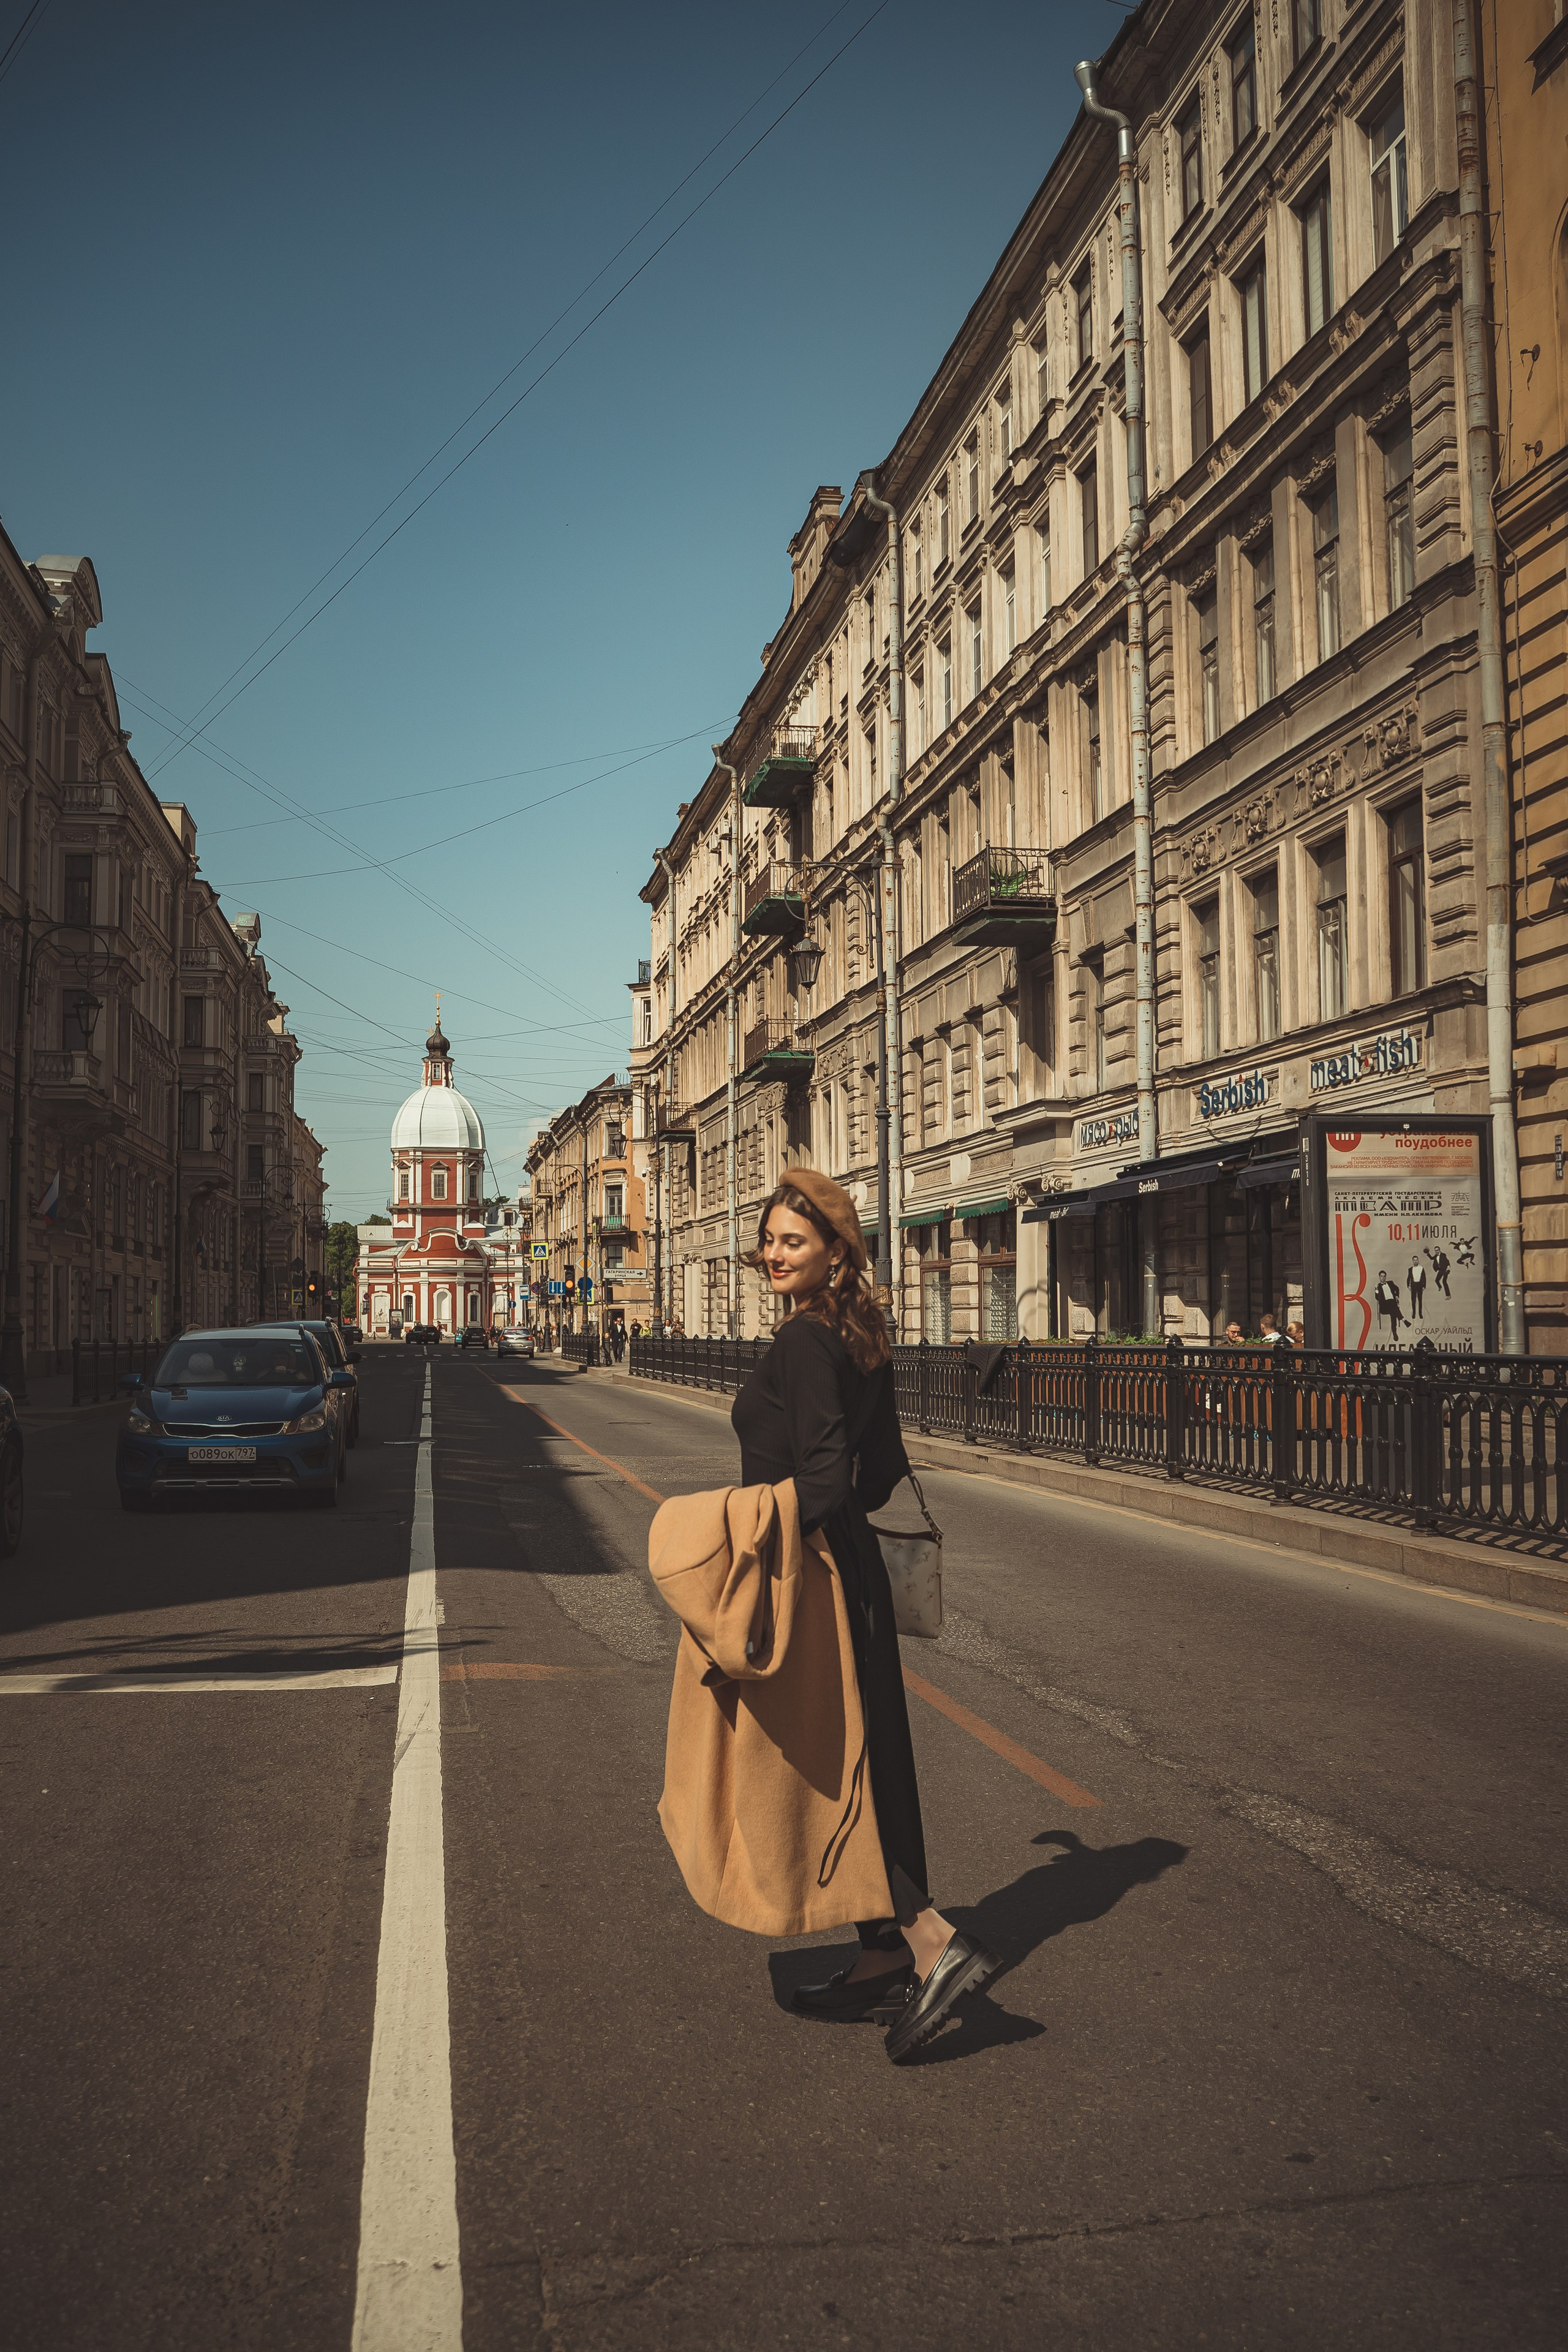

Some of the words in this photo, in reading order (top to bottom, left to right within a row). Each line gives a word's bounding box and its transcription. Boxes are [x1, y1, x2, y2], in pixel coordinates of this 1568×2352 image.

[1311, 1044, 1362, 1089] meat
[1376, 1029, 1418, 1072] fish
[1200, 1069, 1269, 1115] Serbish
[1080, 1121, 1108, 1144] мясо
[1395, 1136, 1472, 1150] поудобнее
[1139, 1178, 1158, 1193] Serbish
[1335, 1200, 1442, 1211] ТЕАТР
[1422, 1225, 1457, 1238] ИЮЛЯ
[237, 1448, 254, 1457] 797
